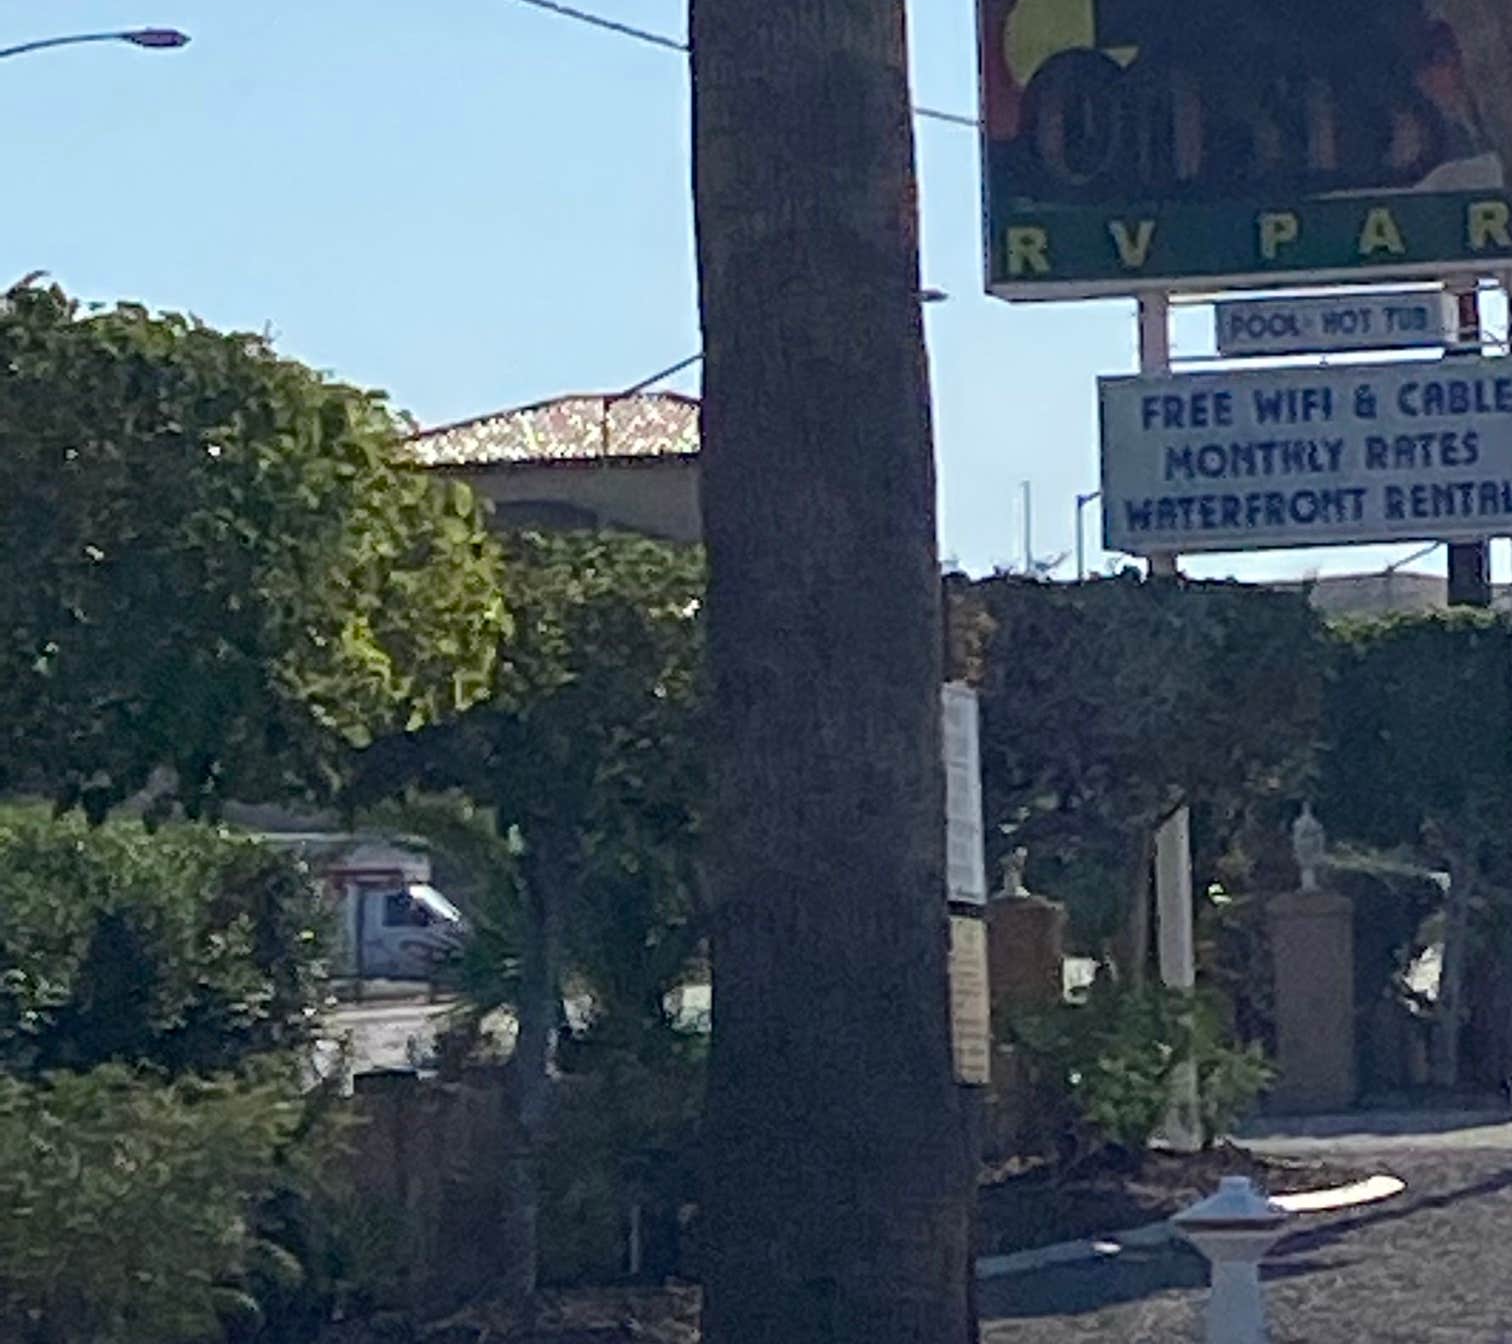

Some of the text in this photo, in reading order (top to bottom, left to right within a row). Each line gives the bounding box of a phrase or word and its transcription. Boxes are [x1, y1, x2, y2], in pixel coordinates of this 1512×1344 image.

[1006, 219, 1155, 275] RV
[1321, 307, 1372, 335] HOT
[1383, 306, 1428, 333] TUB
[1141, 389, 1234, 432] FREE
[1252, 386, 1333, 426] WIFI
[1353, 383, 1377, 421] &
[1163, 430, 1480, 481] MONTHLY RATES
[1123, 486, 1366, 532] WATERFRONT
